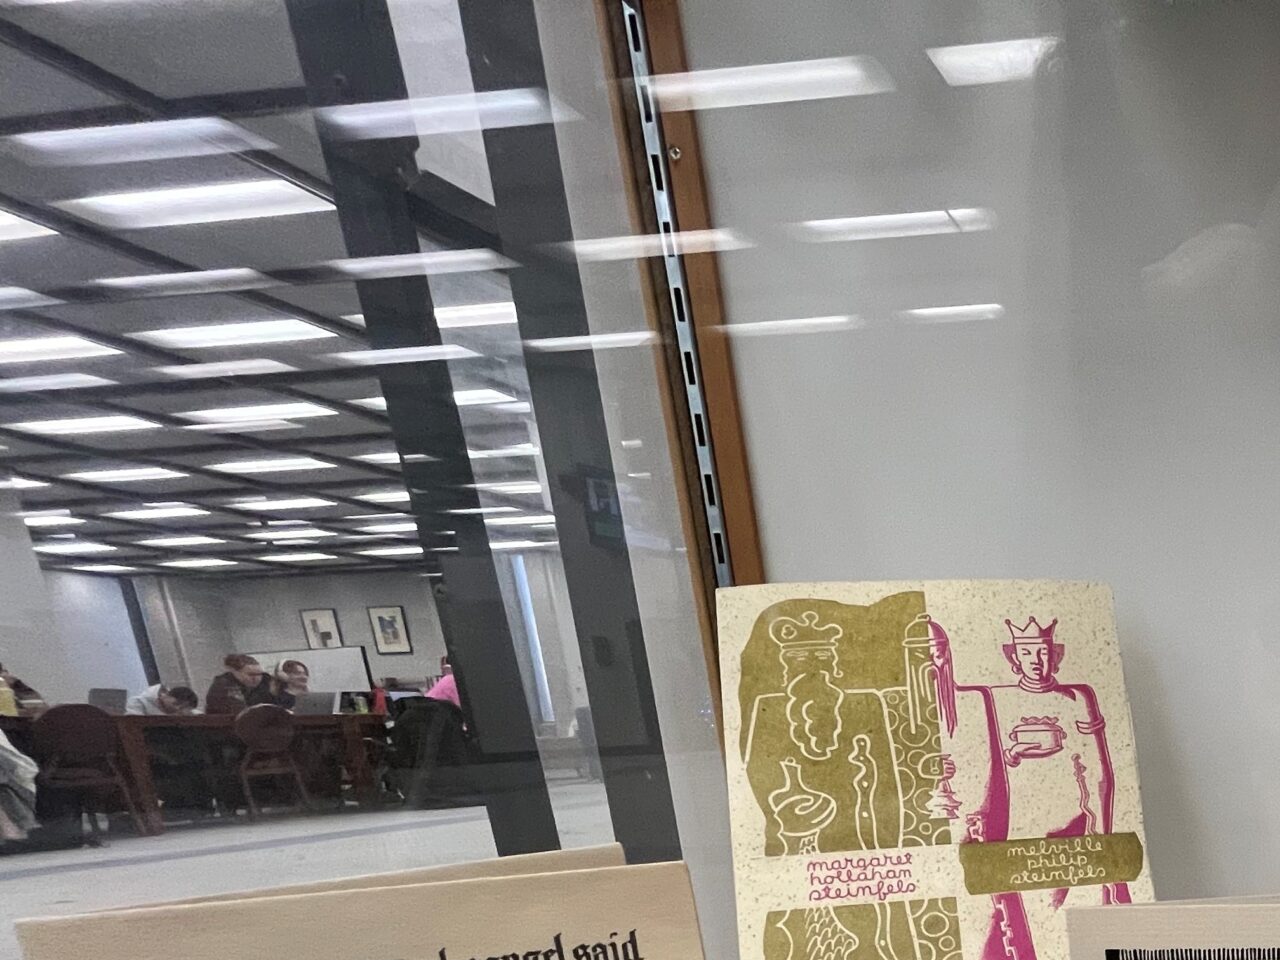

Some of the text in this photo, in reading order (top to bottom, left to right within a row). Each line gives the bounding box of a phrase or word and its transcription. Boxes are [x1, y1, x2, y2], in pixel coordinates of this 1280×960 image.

[1007, 837, 1103, 857] melville
[807, 852, 912, 871] margaret
[1027, 853, 1088, 870] philip
[1010, 865, 1106, 884] steinfels
[809, 880, 916, 901] steinfels
